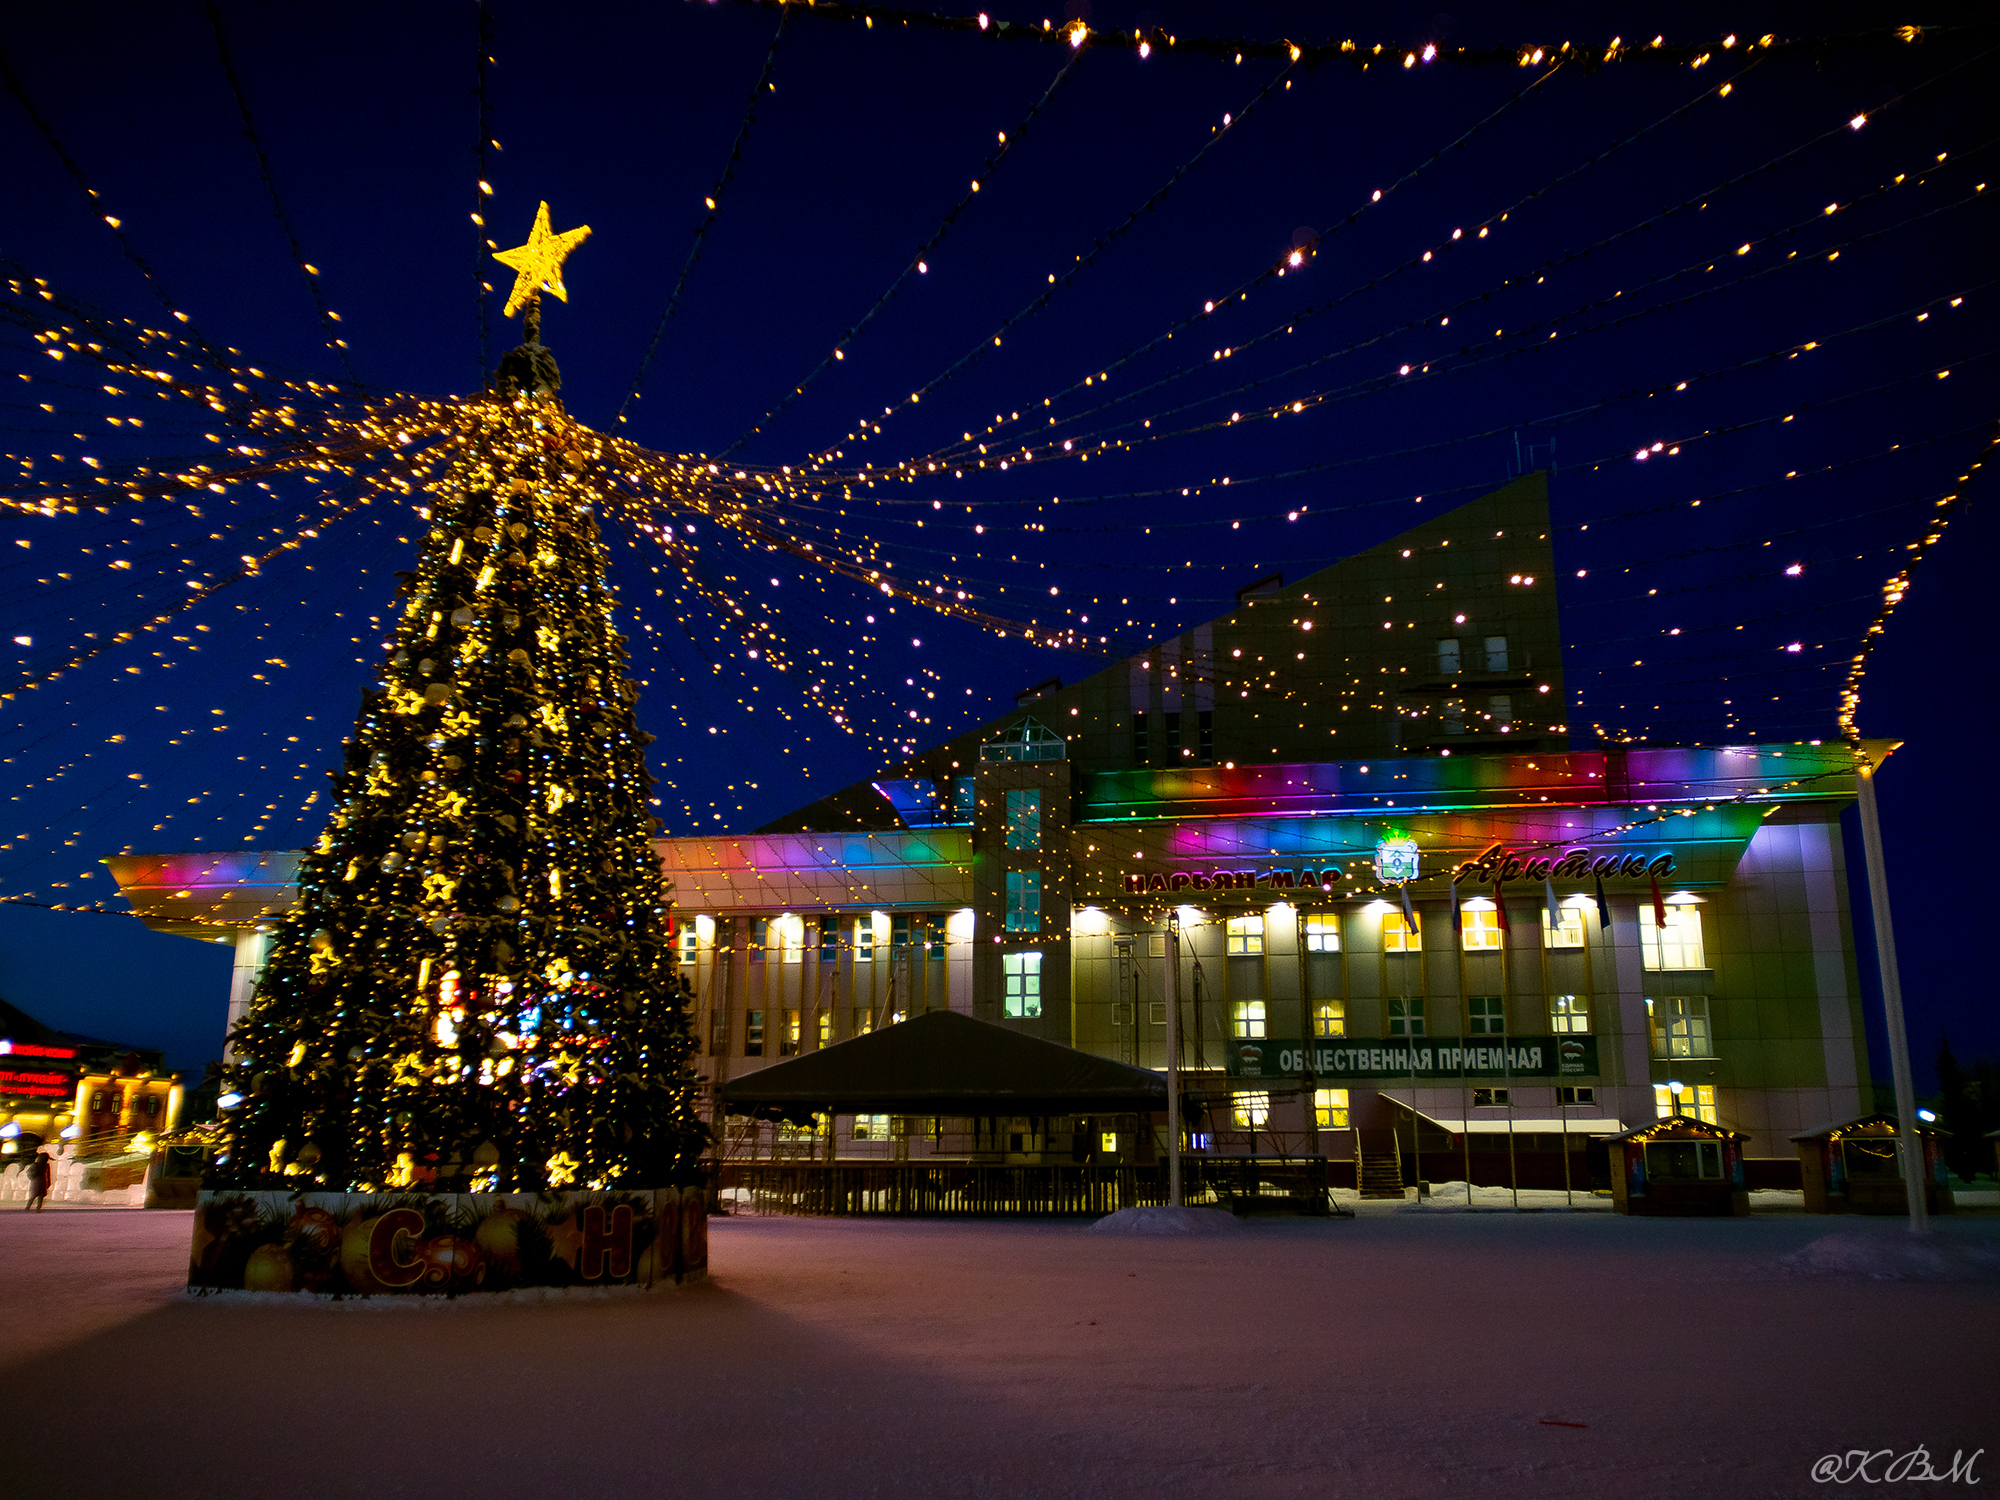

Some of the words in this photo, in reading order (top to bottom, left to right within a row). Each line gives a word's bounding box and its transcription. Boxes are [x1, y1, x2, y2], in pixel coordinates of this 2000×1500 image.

[1123, 867, 1343, 893] НАРЬЯН-МАР
[1453, 842, 1677, 885] Арктика
[1438, 1047, 1543, 1069] ПРИЕМНАЯ
[368, 1208, 427, 1286] С
